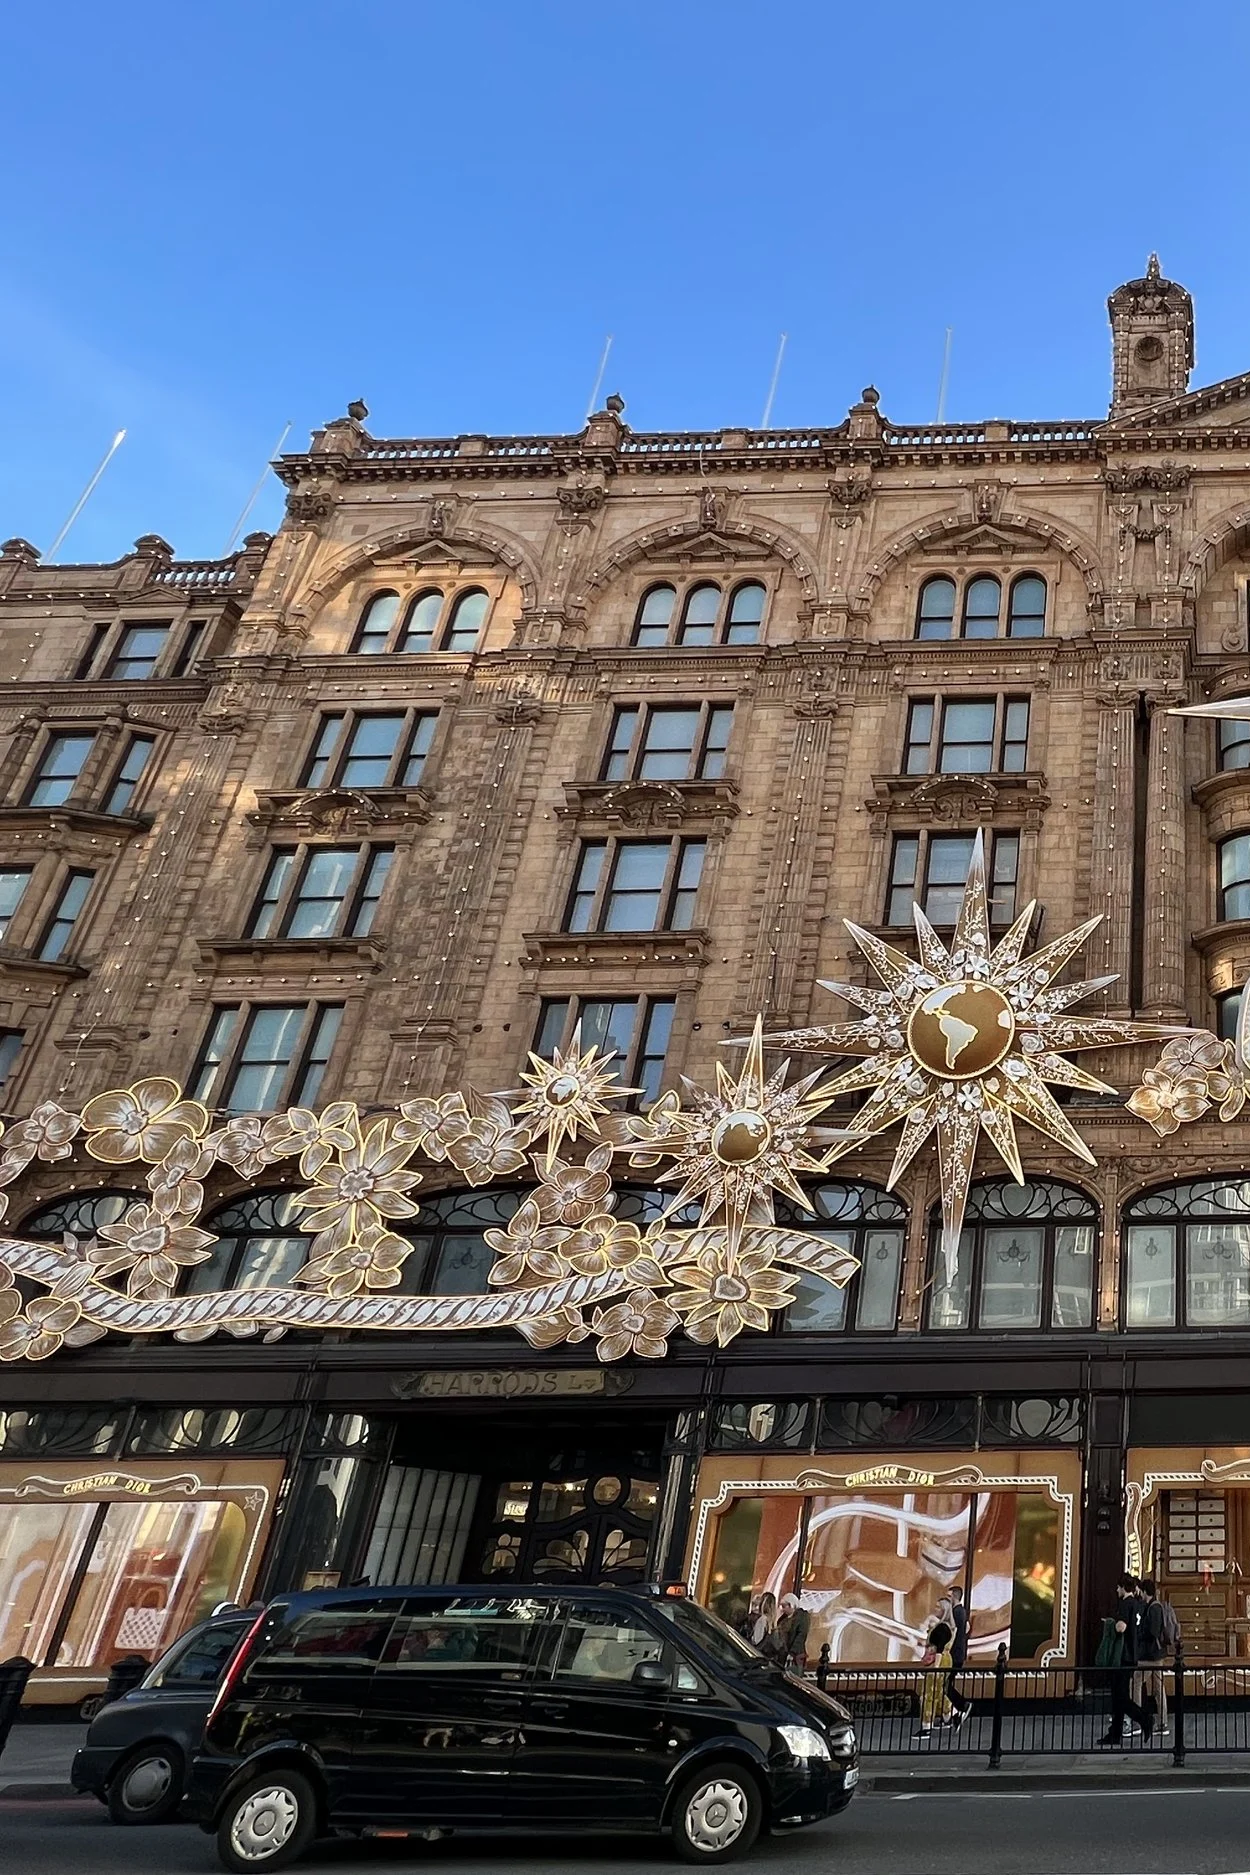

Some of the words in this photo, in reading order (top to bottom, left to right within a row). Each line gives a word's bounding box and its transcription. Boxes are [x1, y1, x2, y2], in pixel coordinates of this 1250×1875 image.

[422, 1371, 558, 1396] HARRODS
[63, 1475, 119, 1495] CHRISTIAN
[124, 1479, 153, 1494] DIOR
[844, 1467, 899, 1488] CHRISTIAN
[907, 1470, 936, 1486] DIOR
